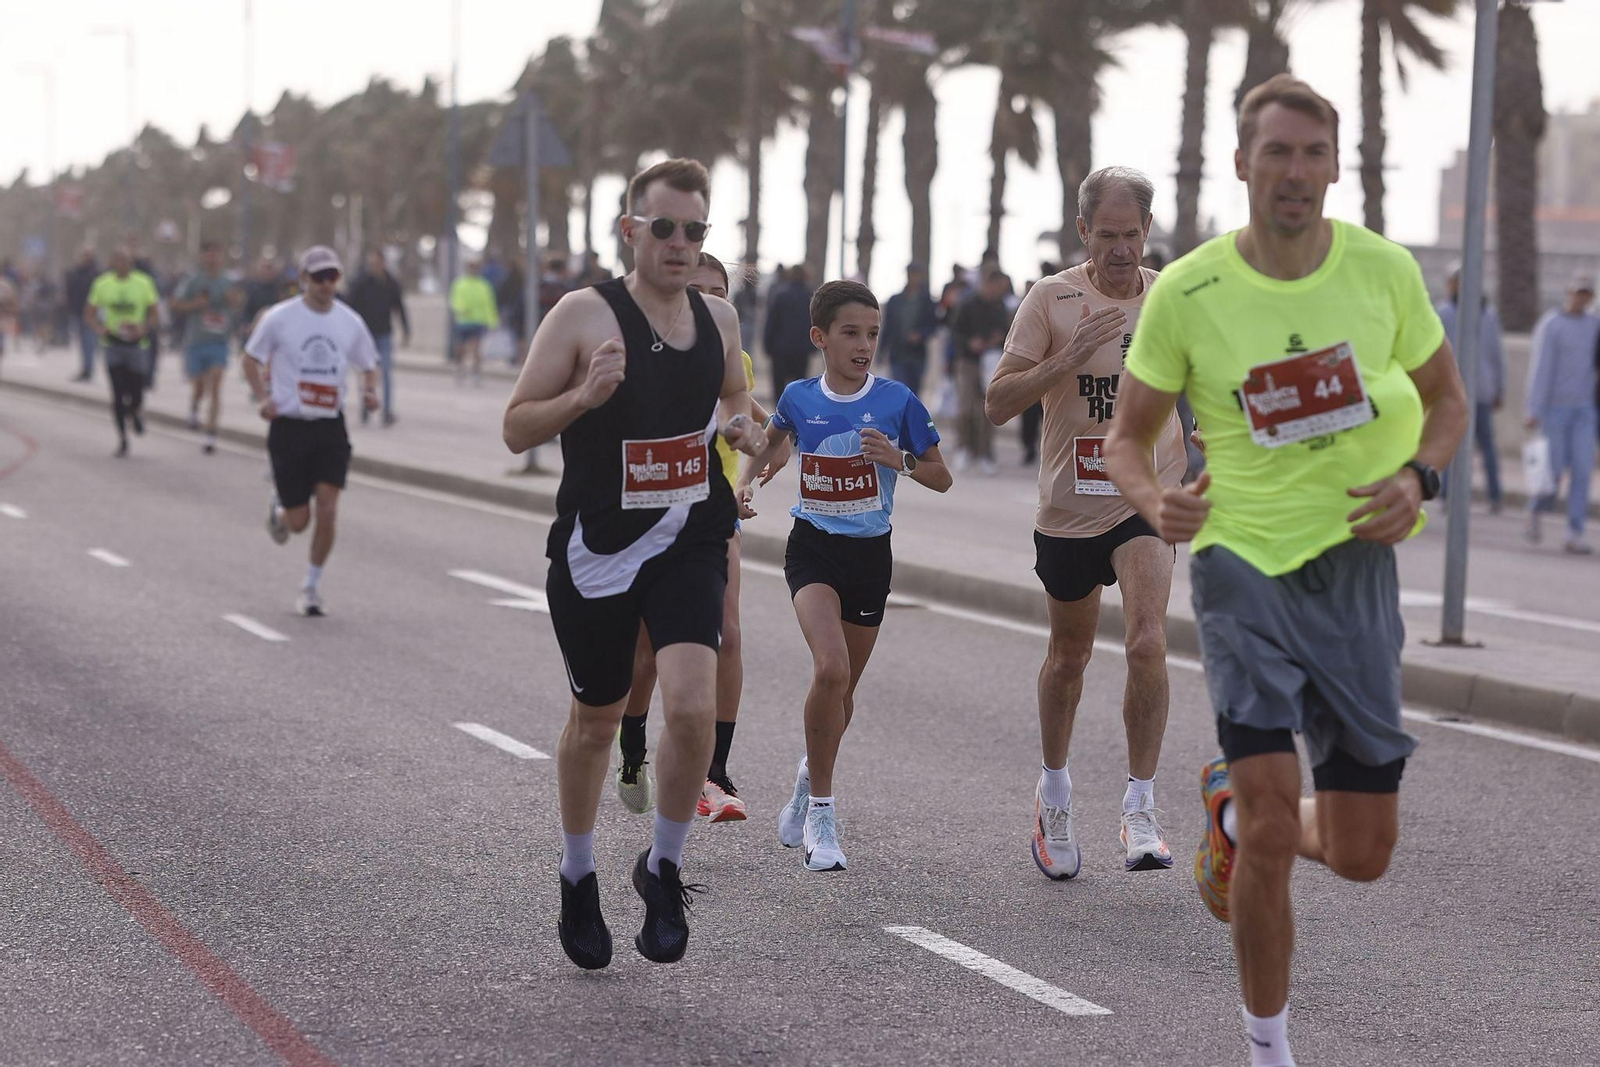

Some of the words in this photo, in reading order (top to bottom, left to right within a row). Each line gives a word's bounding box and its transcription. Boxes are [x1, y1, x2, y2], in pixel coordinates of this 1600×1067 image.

[1077, 374, 1120, 400] BRU
[1314, 374, 1343, 399] 44
[676, 457, 701, 477] 145
[802, 472, 833, 484] BRUNCH
[835, 474, 873, 492] 1541
